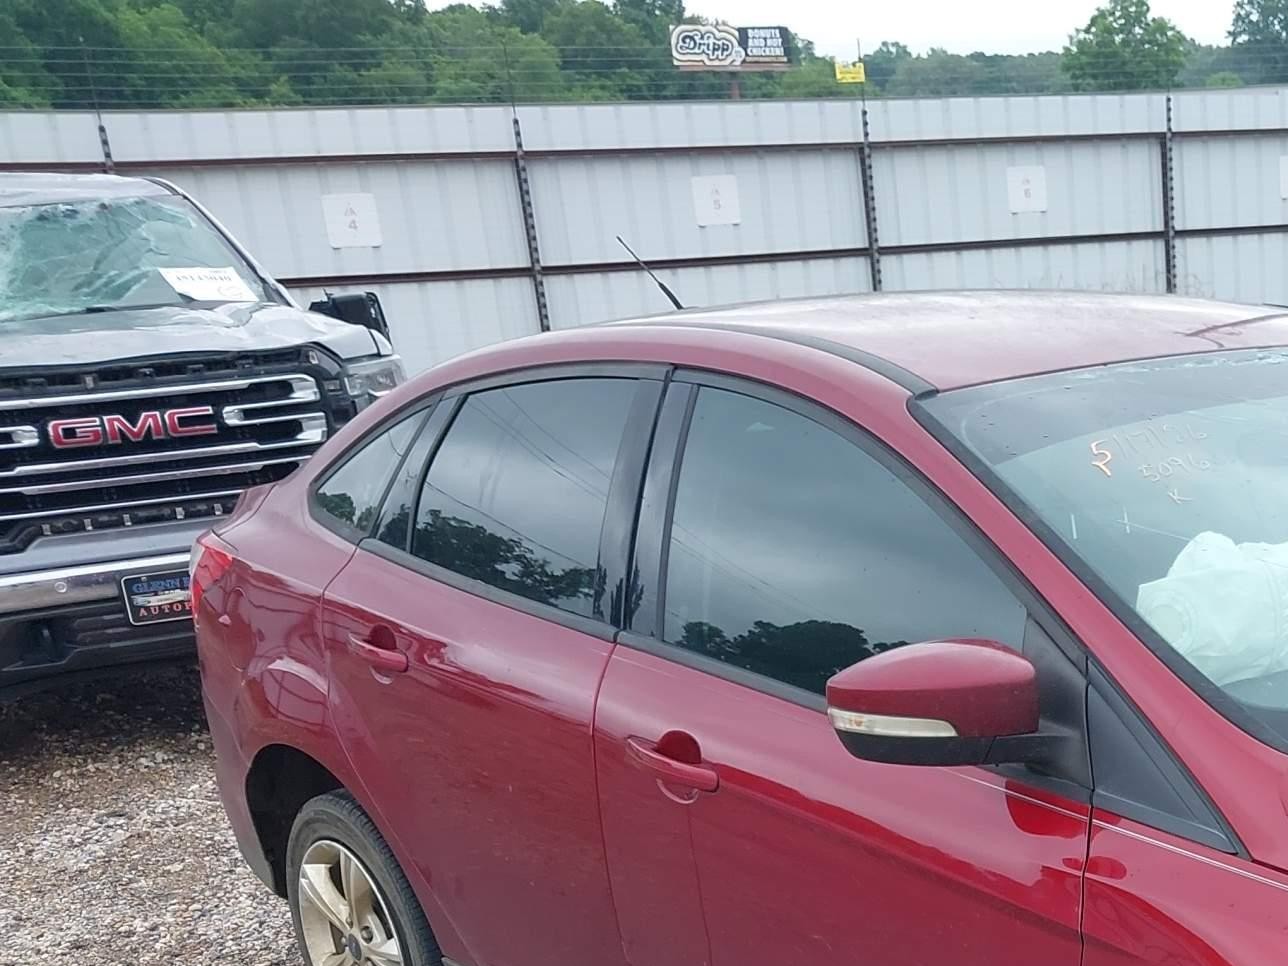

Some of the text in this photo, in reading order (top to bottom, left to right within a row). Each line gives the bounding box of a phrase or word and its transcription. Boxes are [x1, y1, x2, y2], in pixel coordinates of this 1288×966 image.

[747, 28, 780, 37] DONUTS
[679, 32, 731, 58] Dripp
[748, 38, 765, 46] AND
[348, 219, 358, 230] 4
[48, 406, 217, 449] GMC
[132, 578, 180, 592] GLENN
